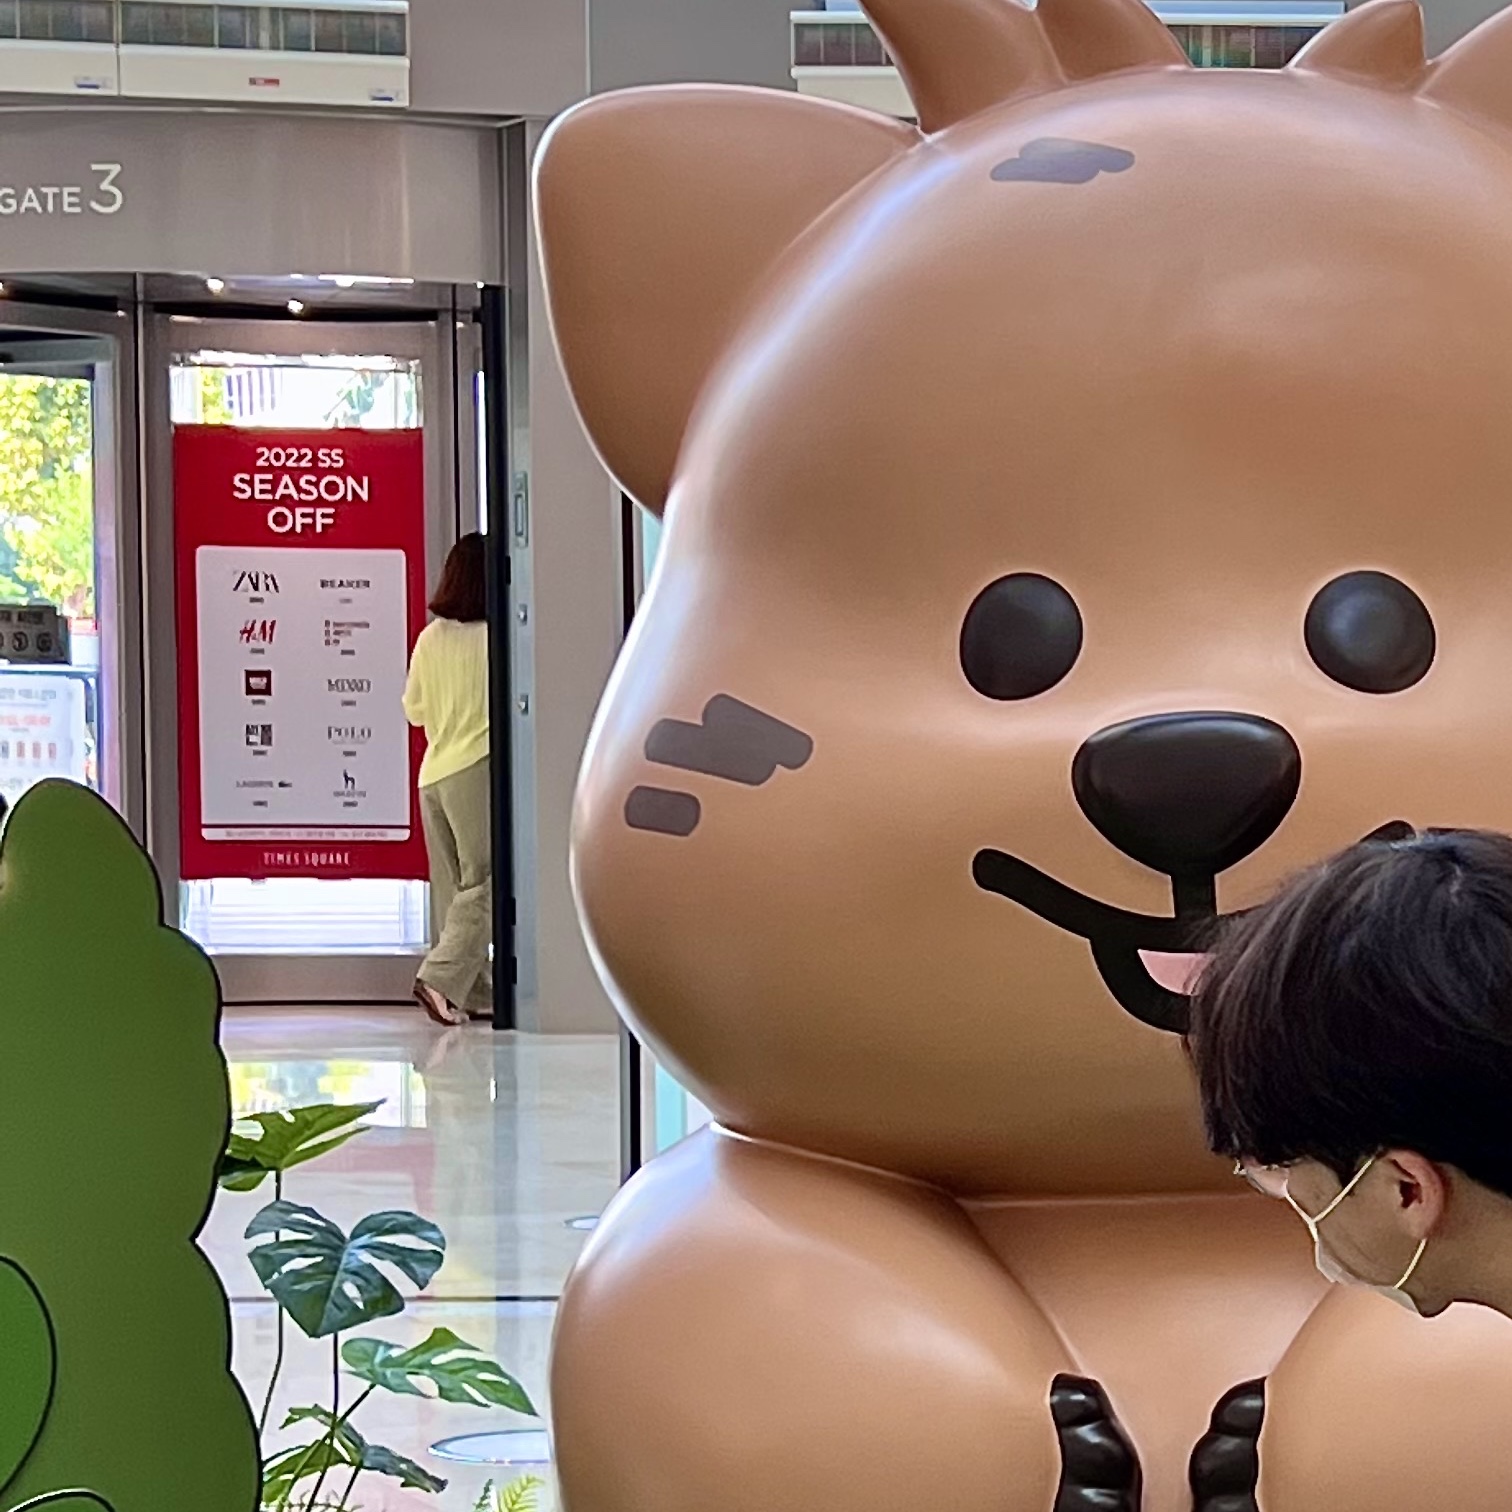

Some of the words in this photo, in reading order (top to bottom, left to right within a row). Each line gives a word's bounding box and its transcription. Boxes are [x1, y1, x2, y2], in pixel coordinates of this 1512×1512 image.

[0, 187, 81, 214] GATE
[90, 163, 123, 213] 3
[256, 447, 312, 467] 2022
[318, 448, 344, 468] SS
[232, 473, 369, 502] SEASON
[267, 506, 335, 533] OFF
[263, 852, 299, 865] TIMES
[304, 852, 350, 867] SQUARE
